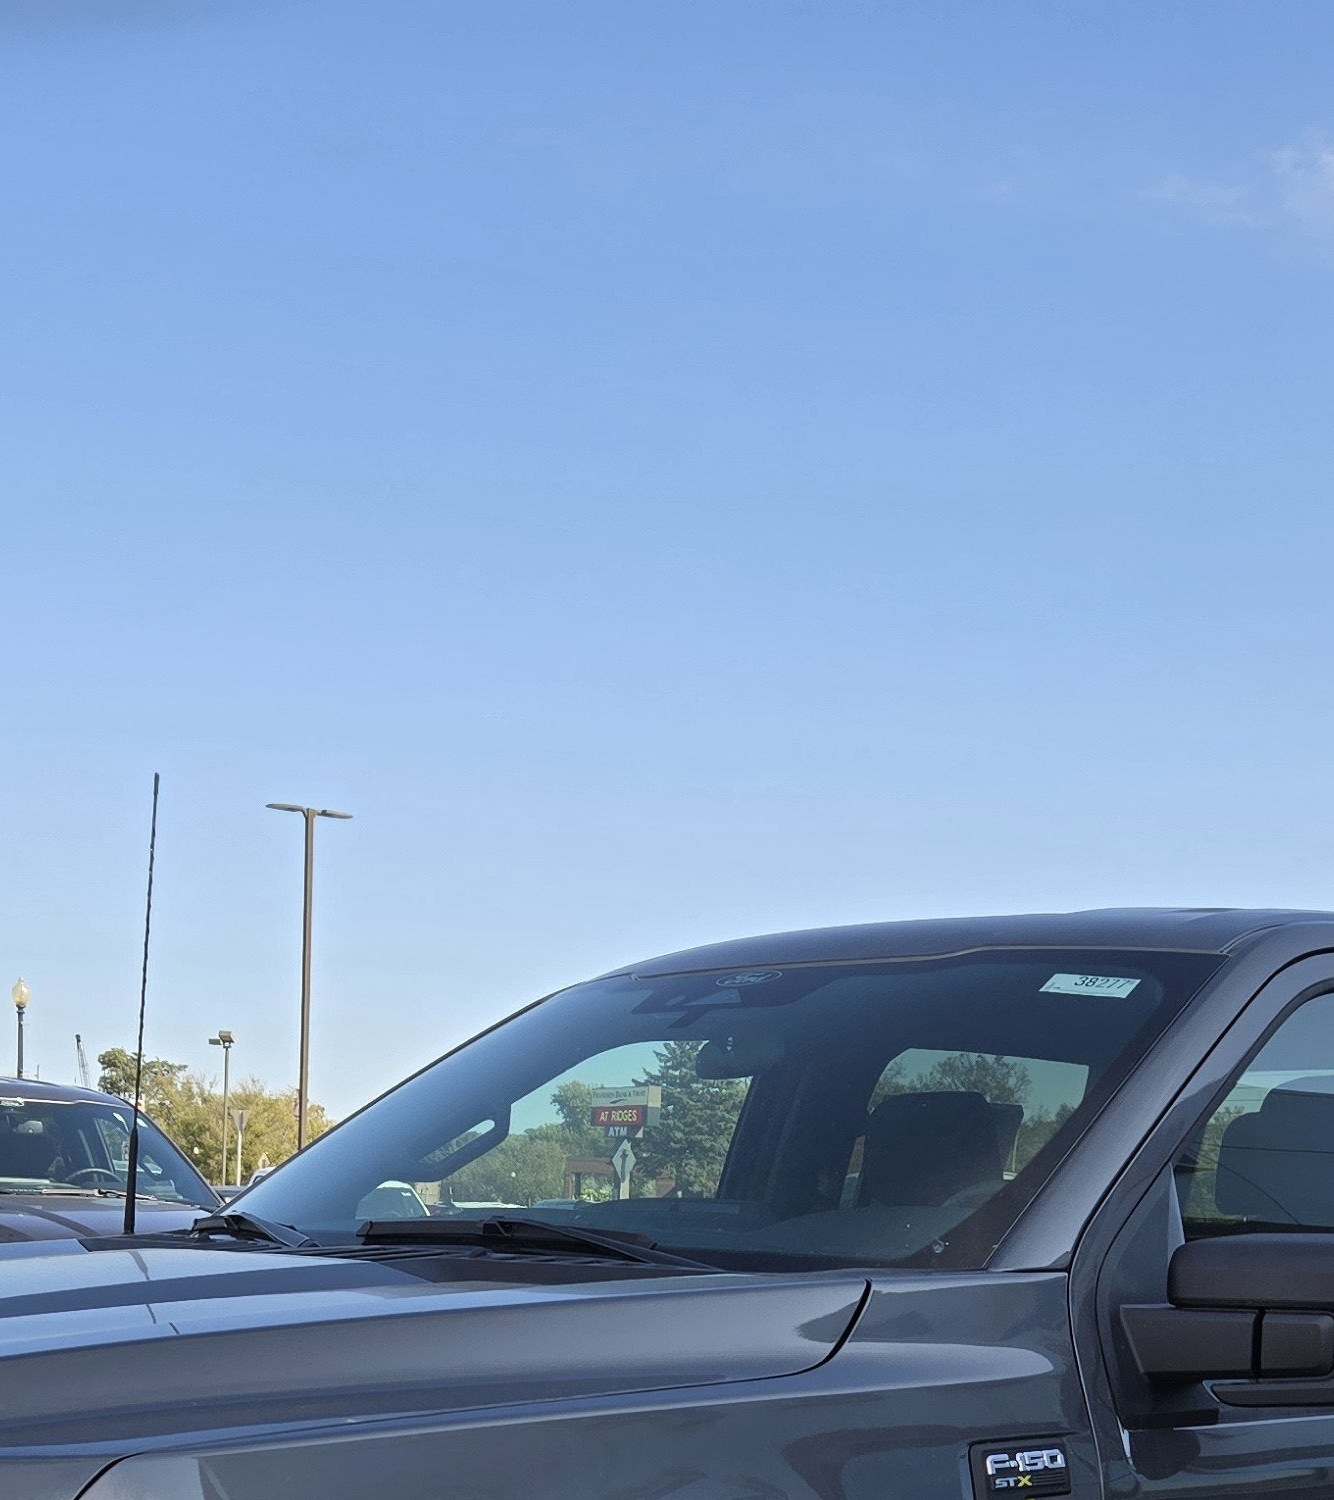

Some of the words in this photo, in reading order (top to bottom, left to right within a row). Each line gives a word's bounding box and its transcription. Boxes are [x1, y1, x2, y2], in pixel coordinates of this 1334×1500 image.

[599, 1112, 610, 1122] AT
[611, 1110, 637, 1122] RIDGES
[608, 1127, 627, 1137] ATM
[986, 1449, 1066, 1475] F-150
[995, 1475, 1033, 1489] STX
